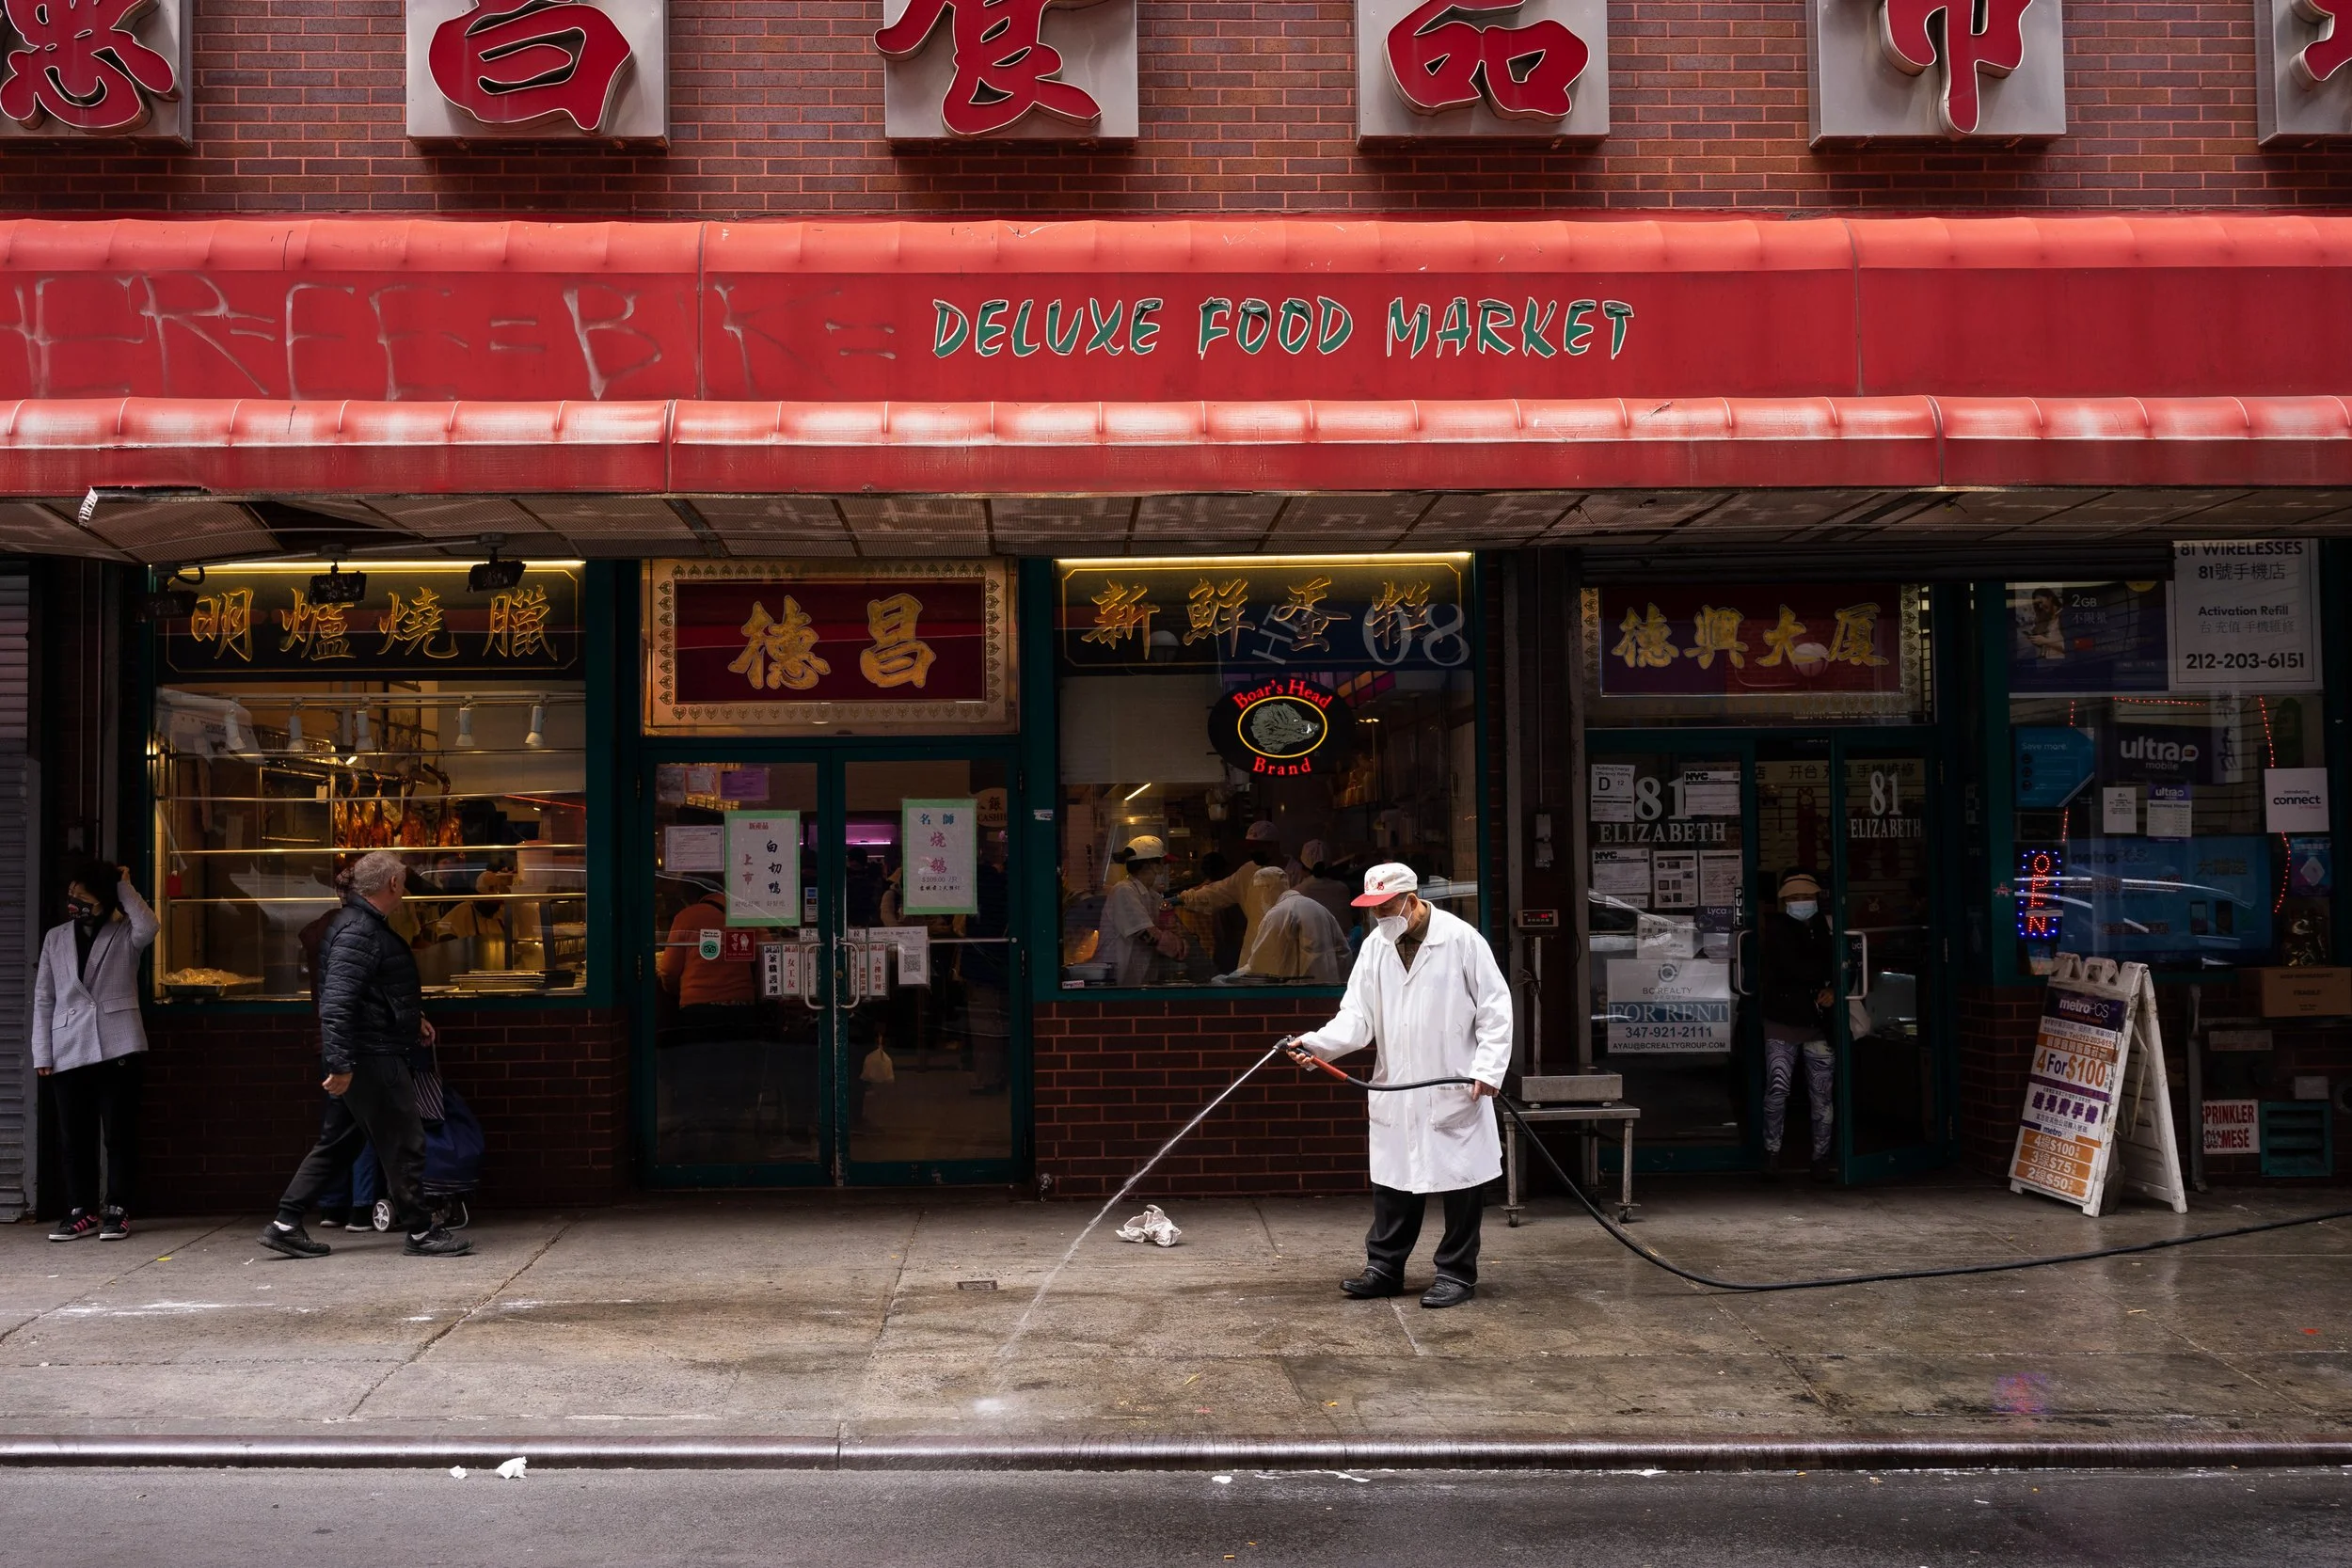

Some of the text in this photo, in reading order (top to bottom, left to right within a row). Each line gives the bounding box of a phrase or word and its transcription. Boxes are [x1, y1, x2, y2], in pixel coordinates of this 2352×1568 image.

[931, 295, 1635, 361] DELUXE FOOD MARKET
[2180, 541, 2303, 556] 81 WIRELESSES
[2198, 605, 2289, 616] Activation Refill
[2186, 653, 2304, 670] 212-203-6151
[1232, 677, 1335, 713] Boar's Head
[1252, 755, 1313, 778] Brand
[1598, 777, 1611, 791] D
[1870, 771, 1902, 816] 81
[1634, 776, 1692, 821] 81
[2273, 795, 2322, 805] connect
[1599, 822, 1727, 843] ELIZABETH
[1850, 818, 1921, 838] ELIZABETH
[1707, 907, 1727, 915] Lyca
[1611, 1004, 1728, 1022] FOR RENT
[1626, 1026, 1712, 1037] 347-921-2111
[2065, 1055, 2106, 1087] $100
